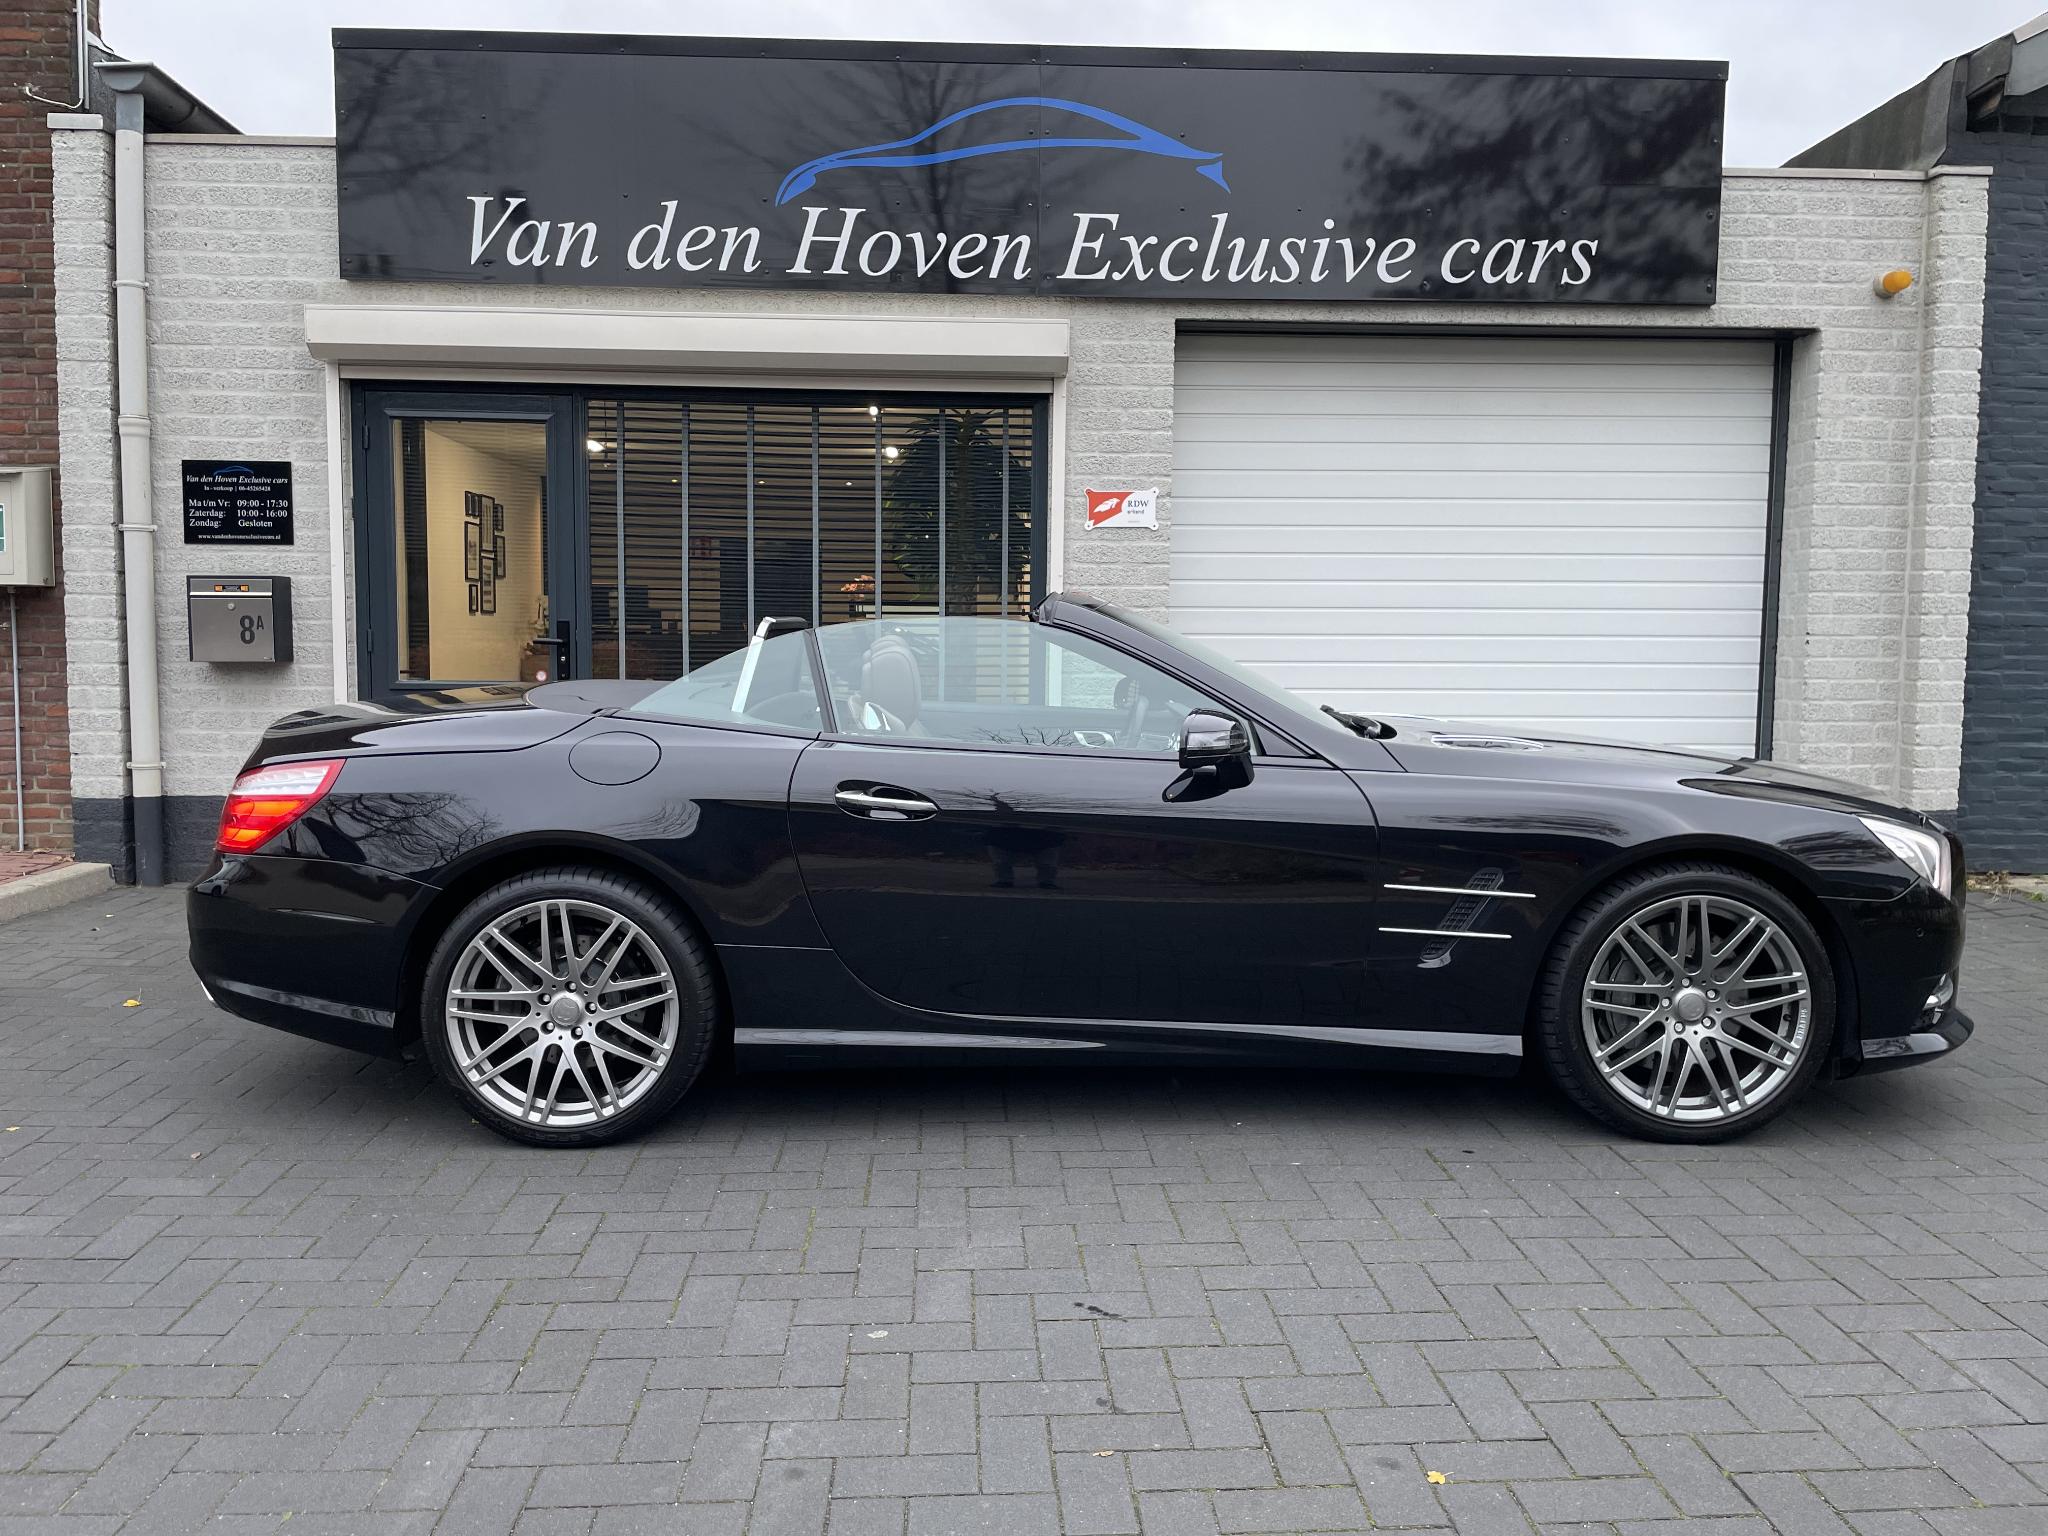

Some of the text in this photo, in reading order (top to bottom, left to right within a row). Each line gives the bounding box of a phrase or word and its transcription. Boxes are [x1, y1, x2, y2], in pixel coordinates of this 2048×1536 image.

[466, 196, 1599, 285] Van den Hoven Exclusive cars
[186, 475, 199, 483] Van
[200, 475, 213, 483] den
[214, 475, 238, 483] Hoven
[238, 476, 272, 484] Exclusive
[189, 499, 202, 507] Ma
[203, 499, 216, 507] t/m
[218, 499, 231, 507] Vr:
[237, 499, 260, 507] 09:00
[189, 509, 227, 518] Zaterdag:
[237, 509, 259, 517] 10:00
[266, 509, 288, 517] 16:00
[189, 519, 273, 528] Zondag: Gesloten
